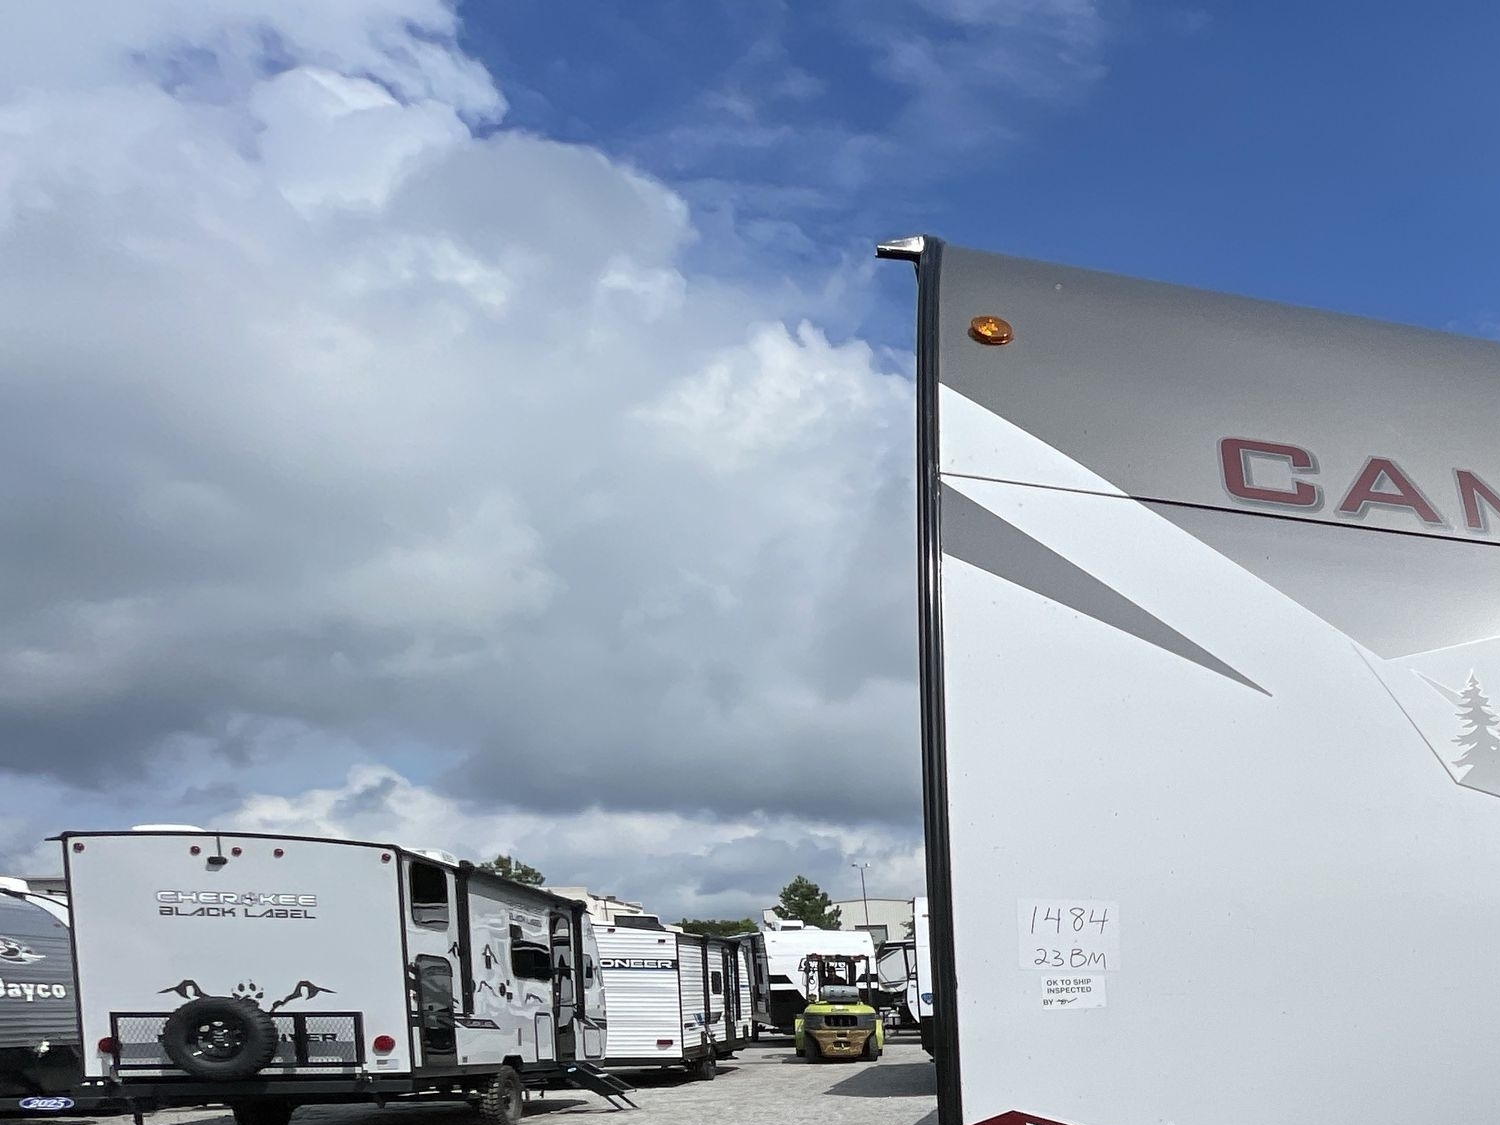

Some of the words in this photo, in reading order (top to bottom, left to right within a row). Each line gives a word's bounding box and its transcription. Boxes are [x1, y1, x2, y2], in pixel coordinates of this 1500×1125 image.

[159, 906, 236, 917] BLACK
[244, 908, 317, 919] LABEL
[1030, 905, 1109, 934] 1484
[1046, 978, 1058, 986] OK
[1060, 978, 1071, 986] TO
[1073, 978, 1092, 986] SHIP
[1046, 986, 1092, 994] INSPECTED
[29, 1099, 66, 1108] 2025
